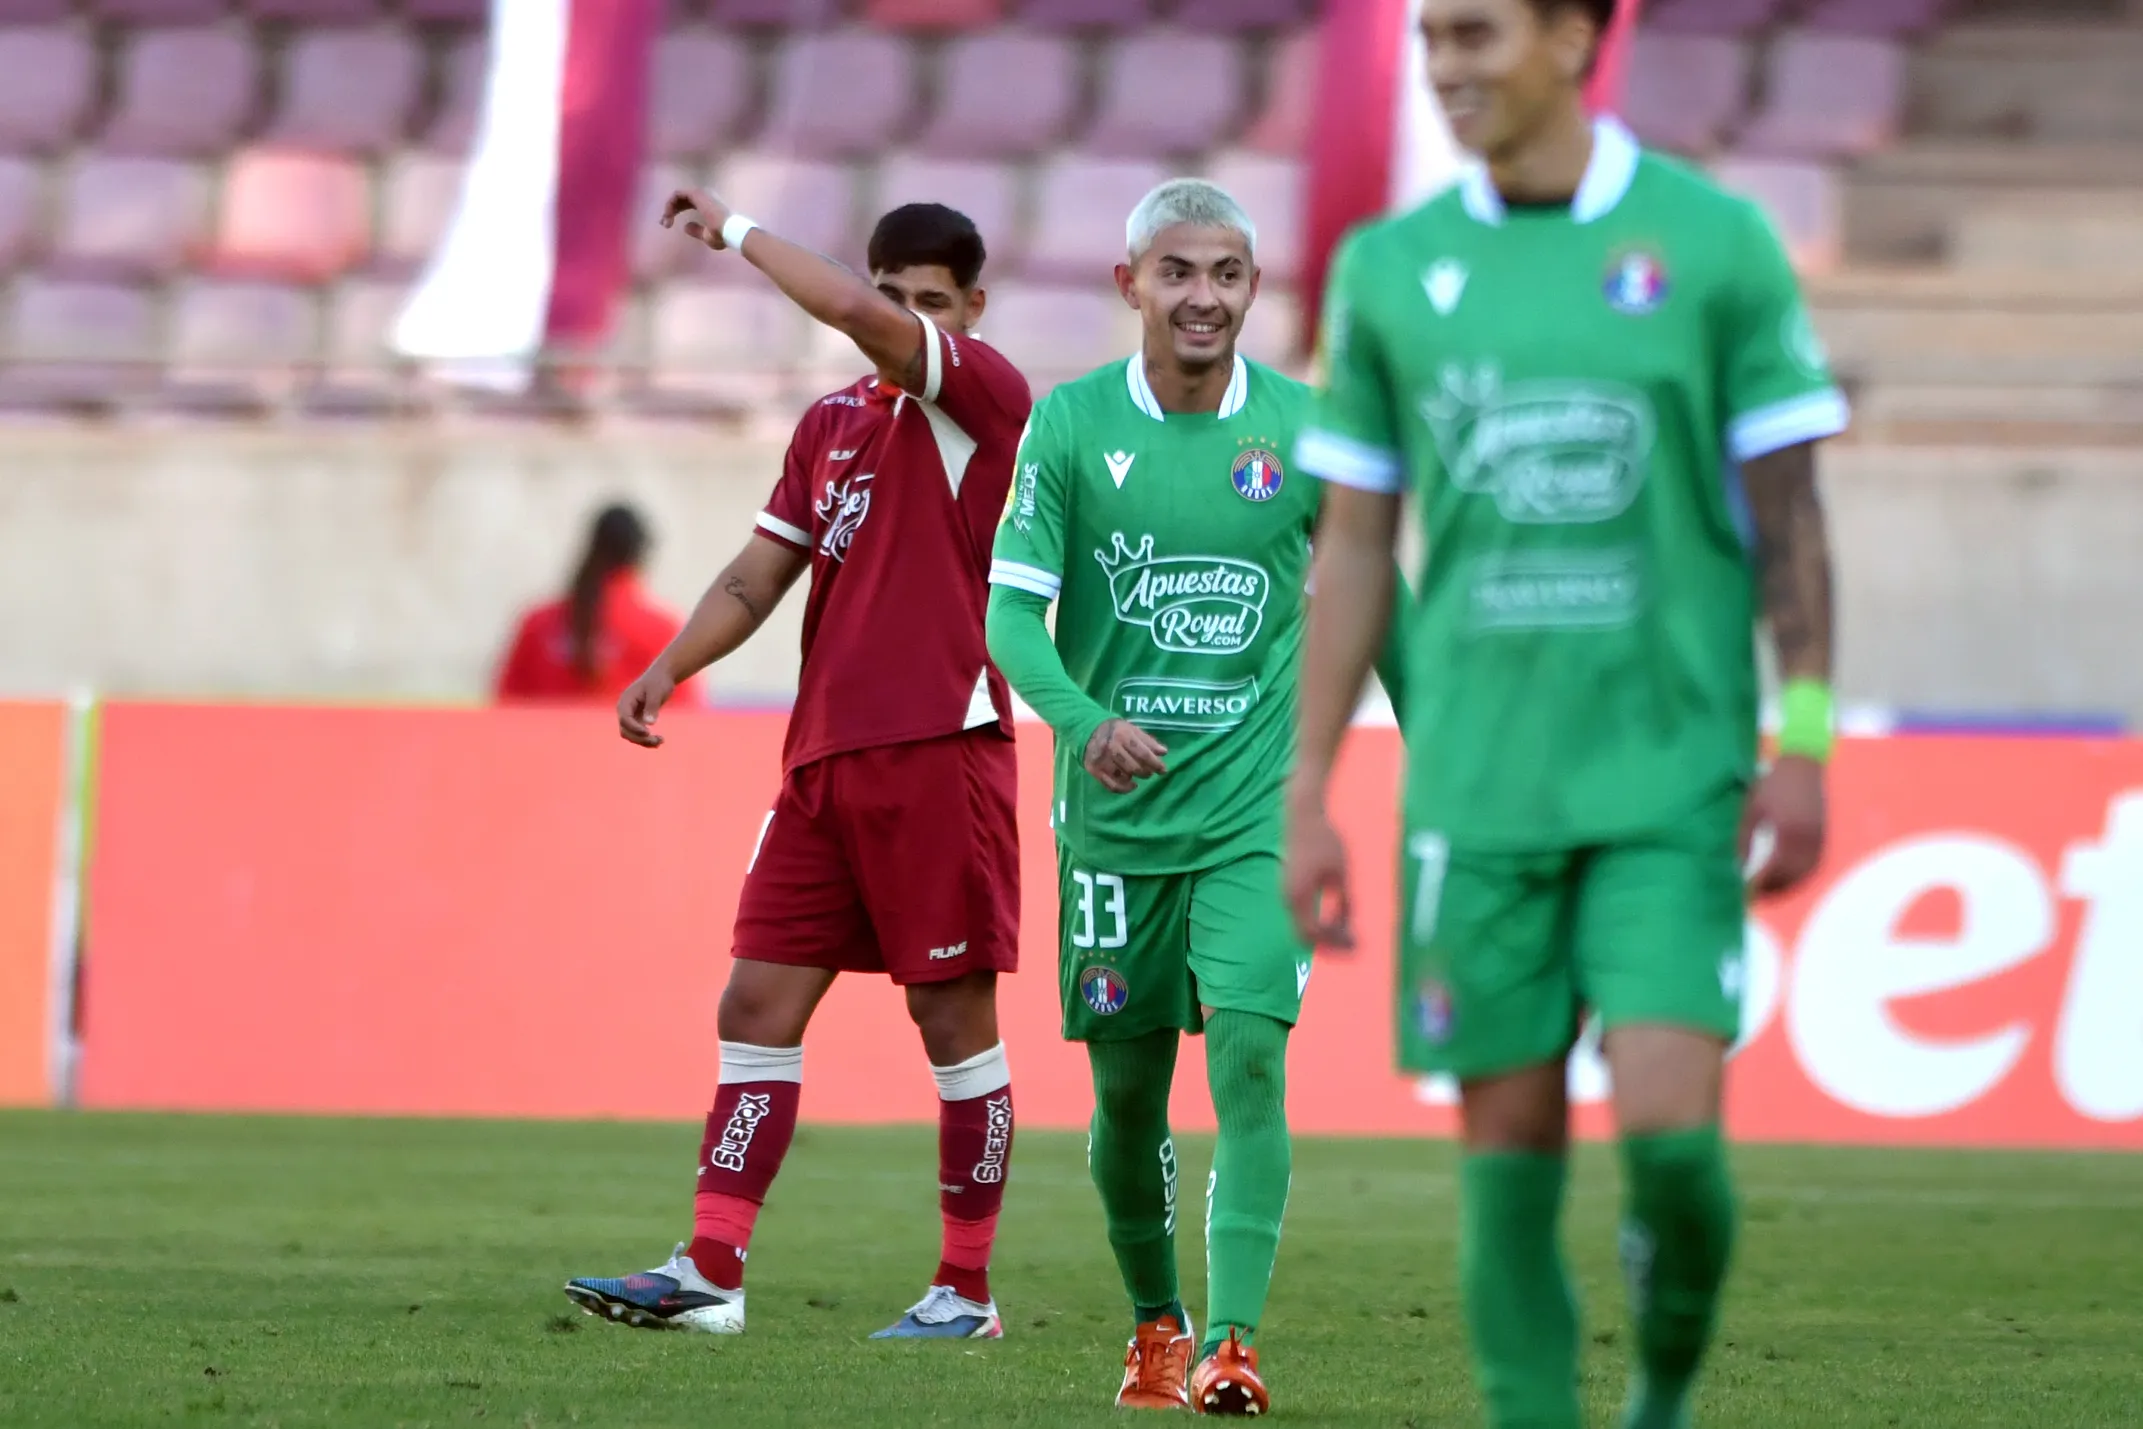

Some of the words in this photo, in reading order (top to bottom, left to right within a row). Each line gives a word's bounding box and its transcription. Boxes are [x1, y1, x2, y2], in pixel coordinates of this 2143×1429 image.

[1020, 462, 1039, 517] MEDS
[1120, 564, 1259, 614] Apuestas
[1161, 606, 1248, 647] Royal
[1122, 694, 1248, 714] TRAVERSO
[1073, 870, 1128, 948] 33
[711, 1092, 770, 1172] SUEROX
[972, 1095, 1012, 1183] SUEROX
